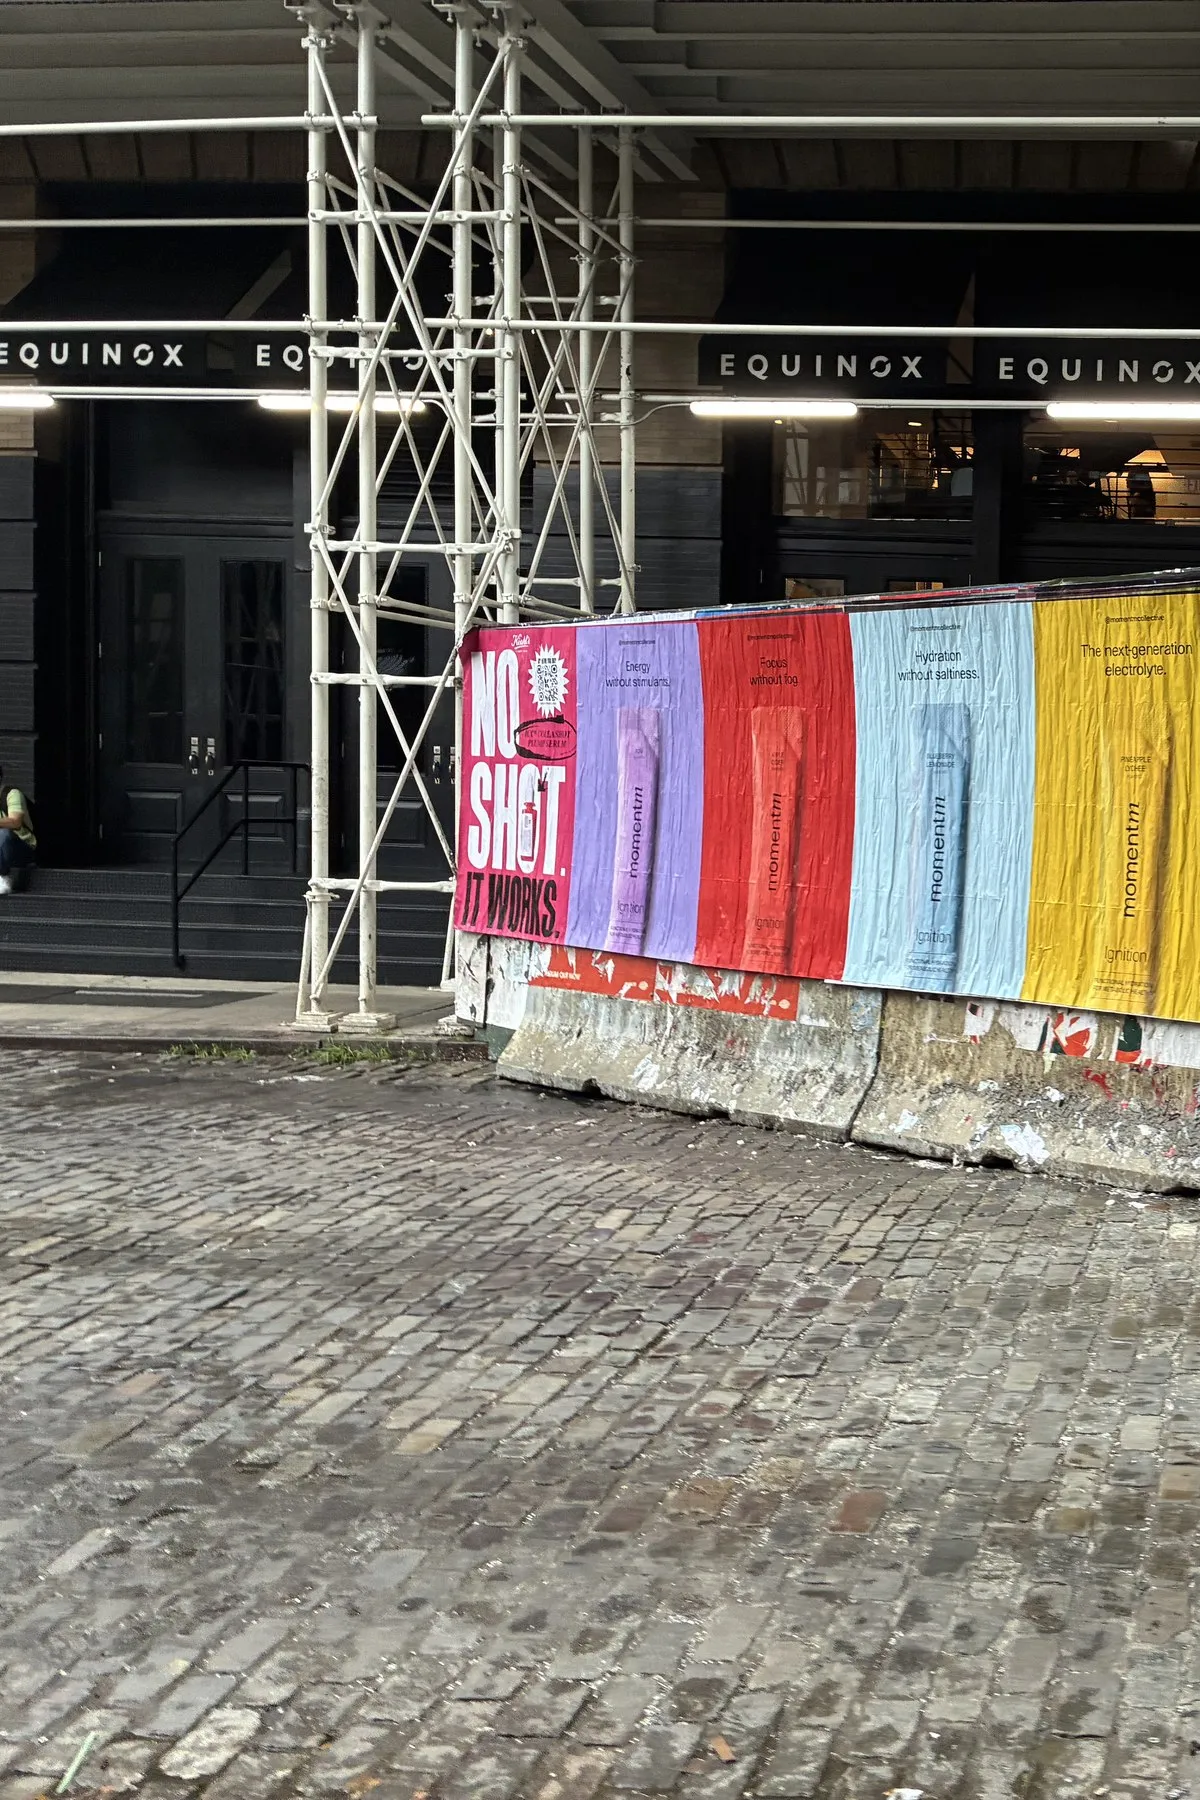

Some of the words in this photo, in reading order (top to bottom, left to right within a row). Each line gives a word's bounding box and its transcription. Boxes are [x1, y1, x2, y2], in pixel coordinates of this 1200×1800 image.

[0, 342, 183, 369] EQUINOX
[720, 353, 923, 380] EQUINOX
[915, 650, 962, 666] Hydration
[1081, 644, 1102, 658] The
[1103, 641, 1193, 660] next-generation
[625, 660, 651, 674] Energy
[760, 656, 788, 669] Focus
[1104, 662, 1167, 679] electrolyte.
[606, 676, 632, 687] without
[632, 675, 670, 688] stimulants.
[750, 673, 783, 686] without
[898, 668, 934, 682] without
[935, 667, 980, 681] saltiness.
[471, 649, 520, 759] NO
[467, 762, 566, 877] SHOT.
[462, 871, 485, 927] IT
[487, 873, 560, 939] WORKS.
[915, 928, 952, 945] Ignition
[1104, 945, 1147, 964] Ignition
